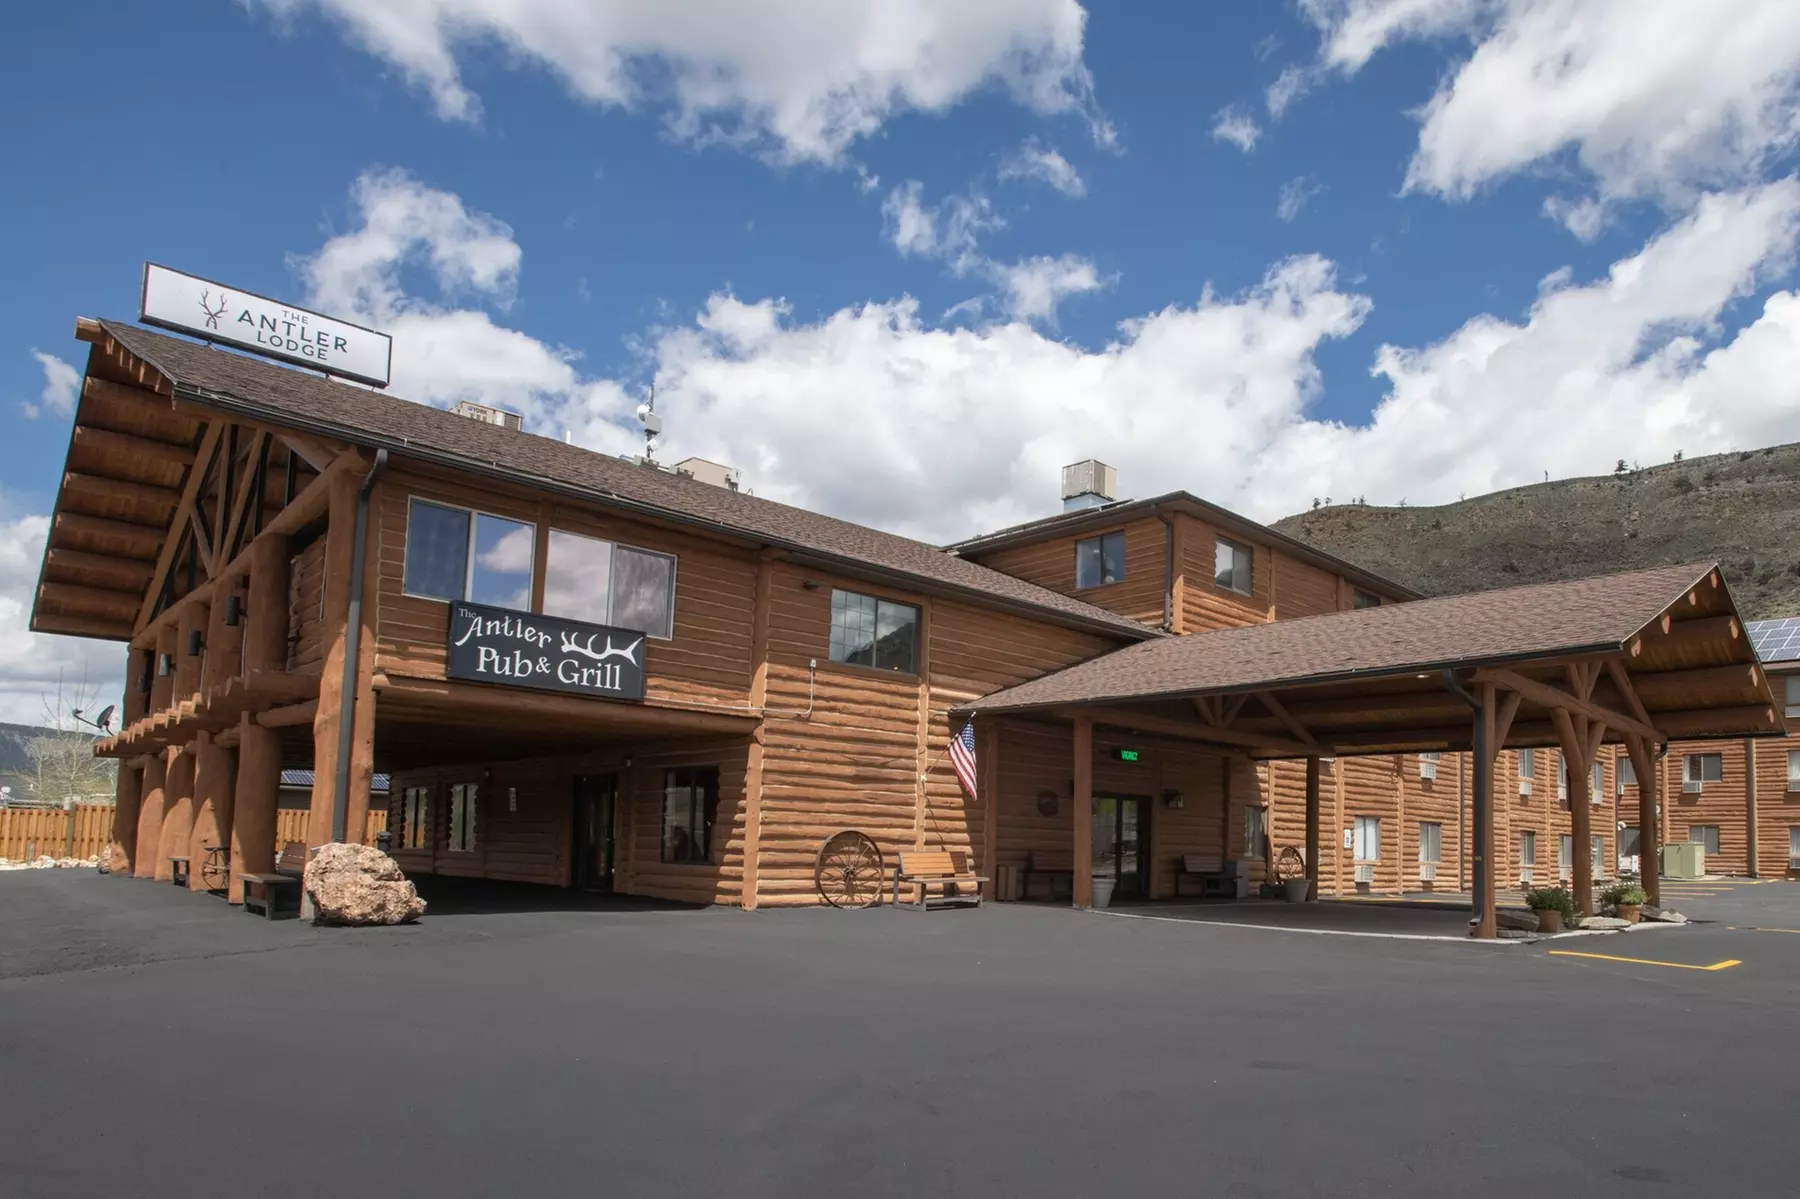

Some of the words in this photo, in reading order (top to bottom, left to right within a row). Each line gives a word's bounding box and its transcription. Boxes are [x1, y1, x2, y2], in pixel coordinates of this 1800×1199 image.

[237, 309, 348, 353] ANTLER
[282, 309, 309, 324] THE
[257, 331, 328, 361] LODGE
[458, 607, 477, 619] The
[454, 615, 552, 649] Antler
[476, 645, 533, 678] Pub
[535, 656, 552, 675] &
[557, 659, 622, 691] Grill
